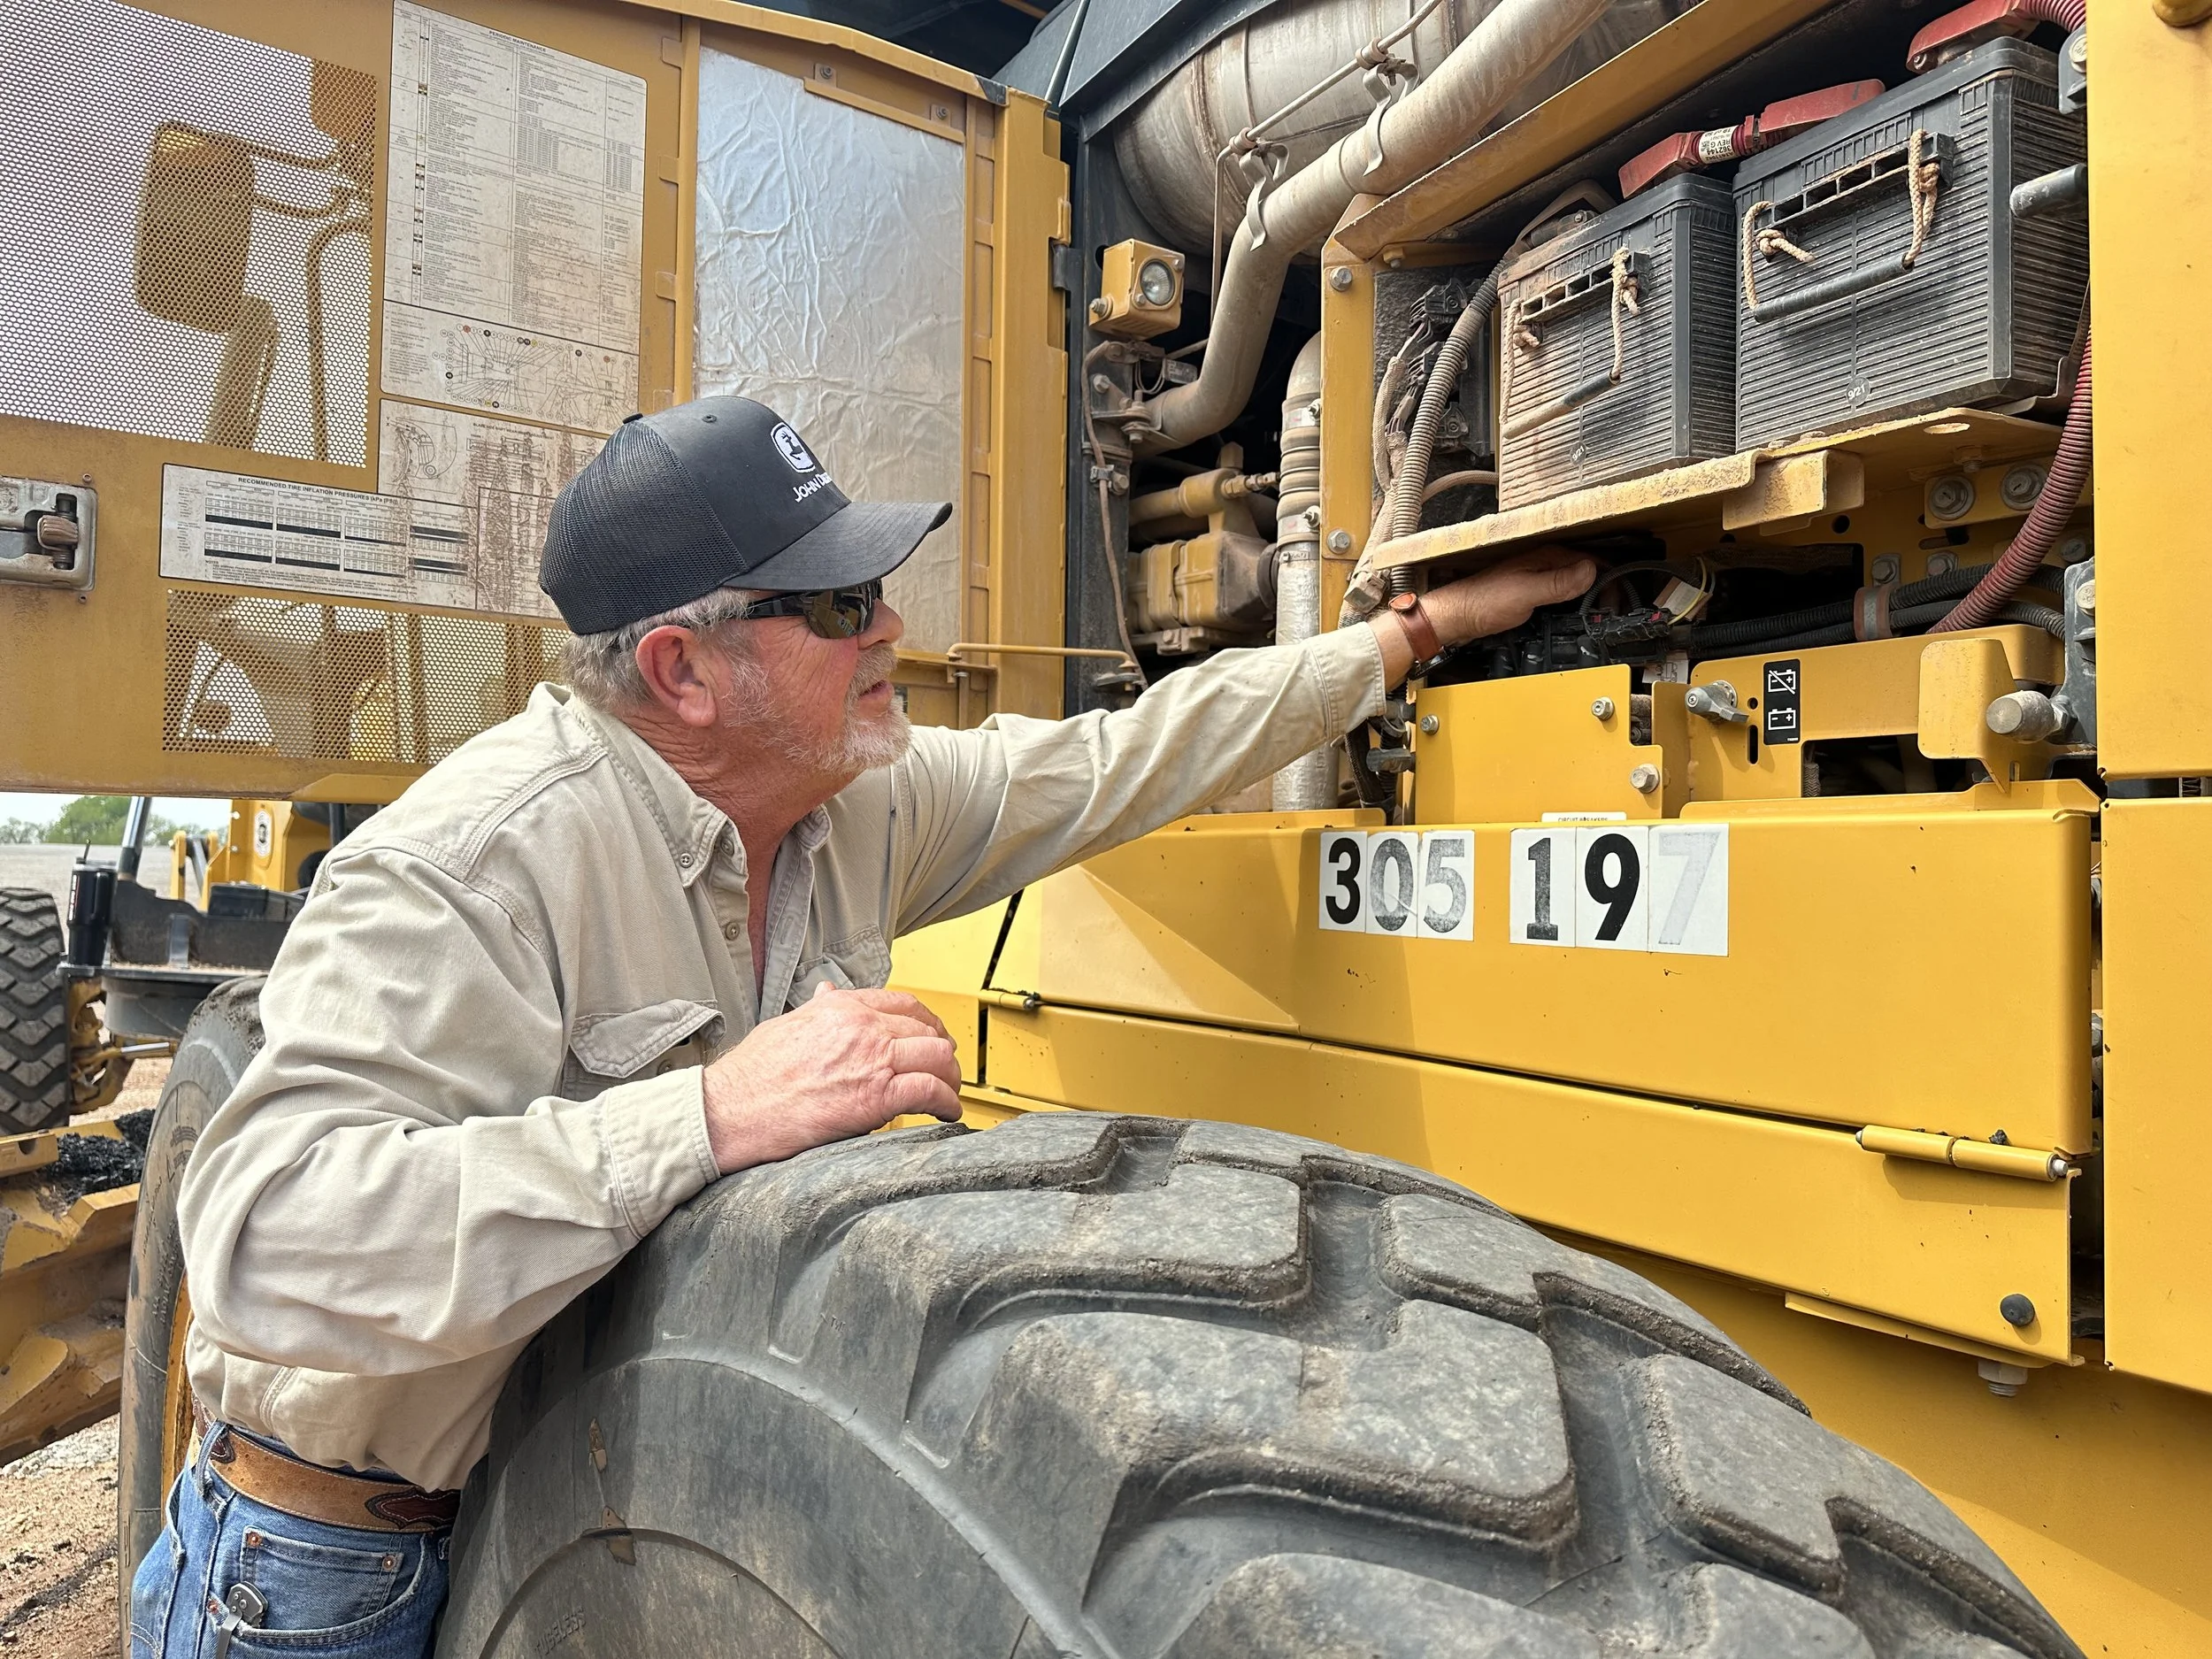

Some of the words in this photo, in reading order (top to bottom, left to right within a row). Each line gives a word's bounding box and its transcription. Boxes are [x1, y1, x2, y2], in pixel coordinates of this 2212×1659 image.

[489, 30, 511, 42] PERIODIC
[513, 38, 547, 53] MAINTENANCE
[1848, 383, 1865, 400] 9/21
[1571, 445, 1585, 461] 9/21
[238, 477, 287, 488] RECOMMENDED
[303, 487, 334, 495] INFLATION
[334, 491, 370, 502] PRESSURES
[792, 478, 822, 503] JOHN
[1325, 837, 1466, 933] 305
[1526, 832, 1721, 945] 197
